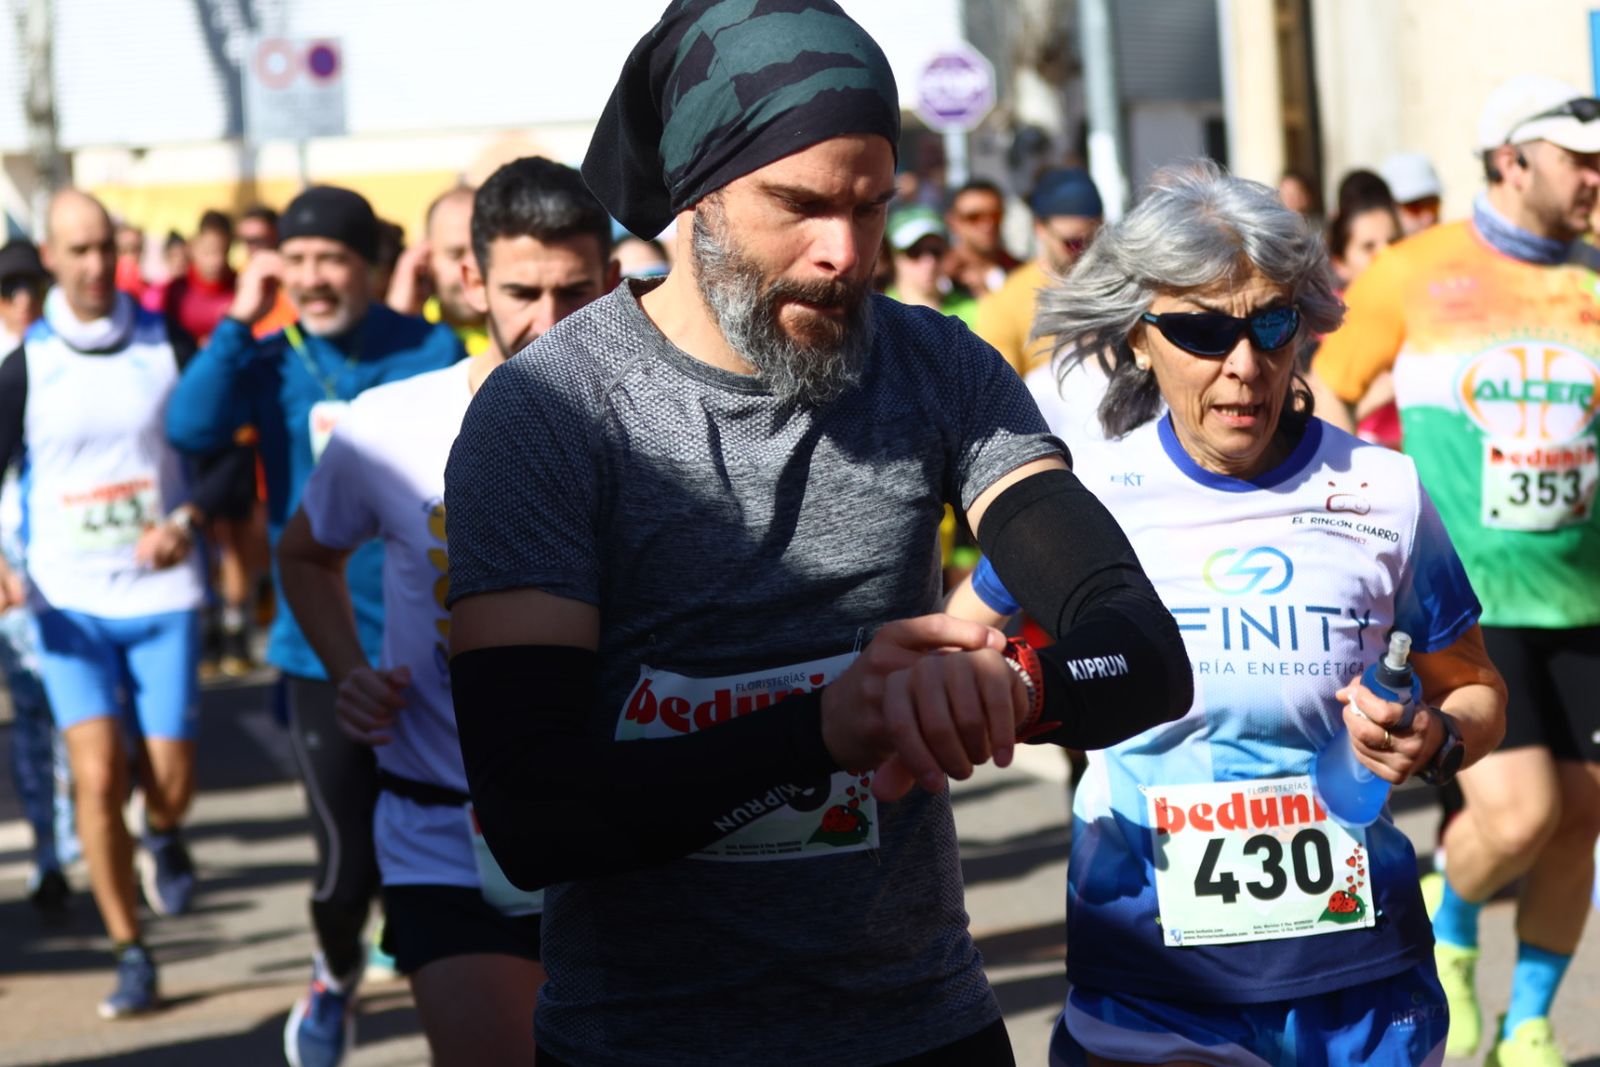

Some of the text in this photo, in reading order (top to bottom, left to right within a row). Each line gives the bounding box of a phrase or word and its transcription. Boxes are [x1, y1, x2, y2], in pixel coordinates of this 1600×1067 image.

[1508, 470, 1581, 506] 353
[1292, 516, 1305, 525] EL
[1356, 523, 1399, 543] CHARRO
[1066, 653, 1129, 681] KIPRUN
[1247, 658, 1365, 676] ENERGÉTICA
[735, 672, 806, 693] FLORISTERÍAS
[713, 783, 802, 833] KIPRUN
[1194, 828, 1334, 904] 430
